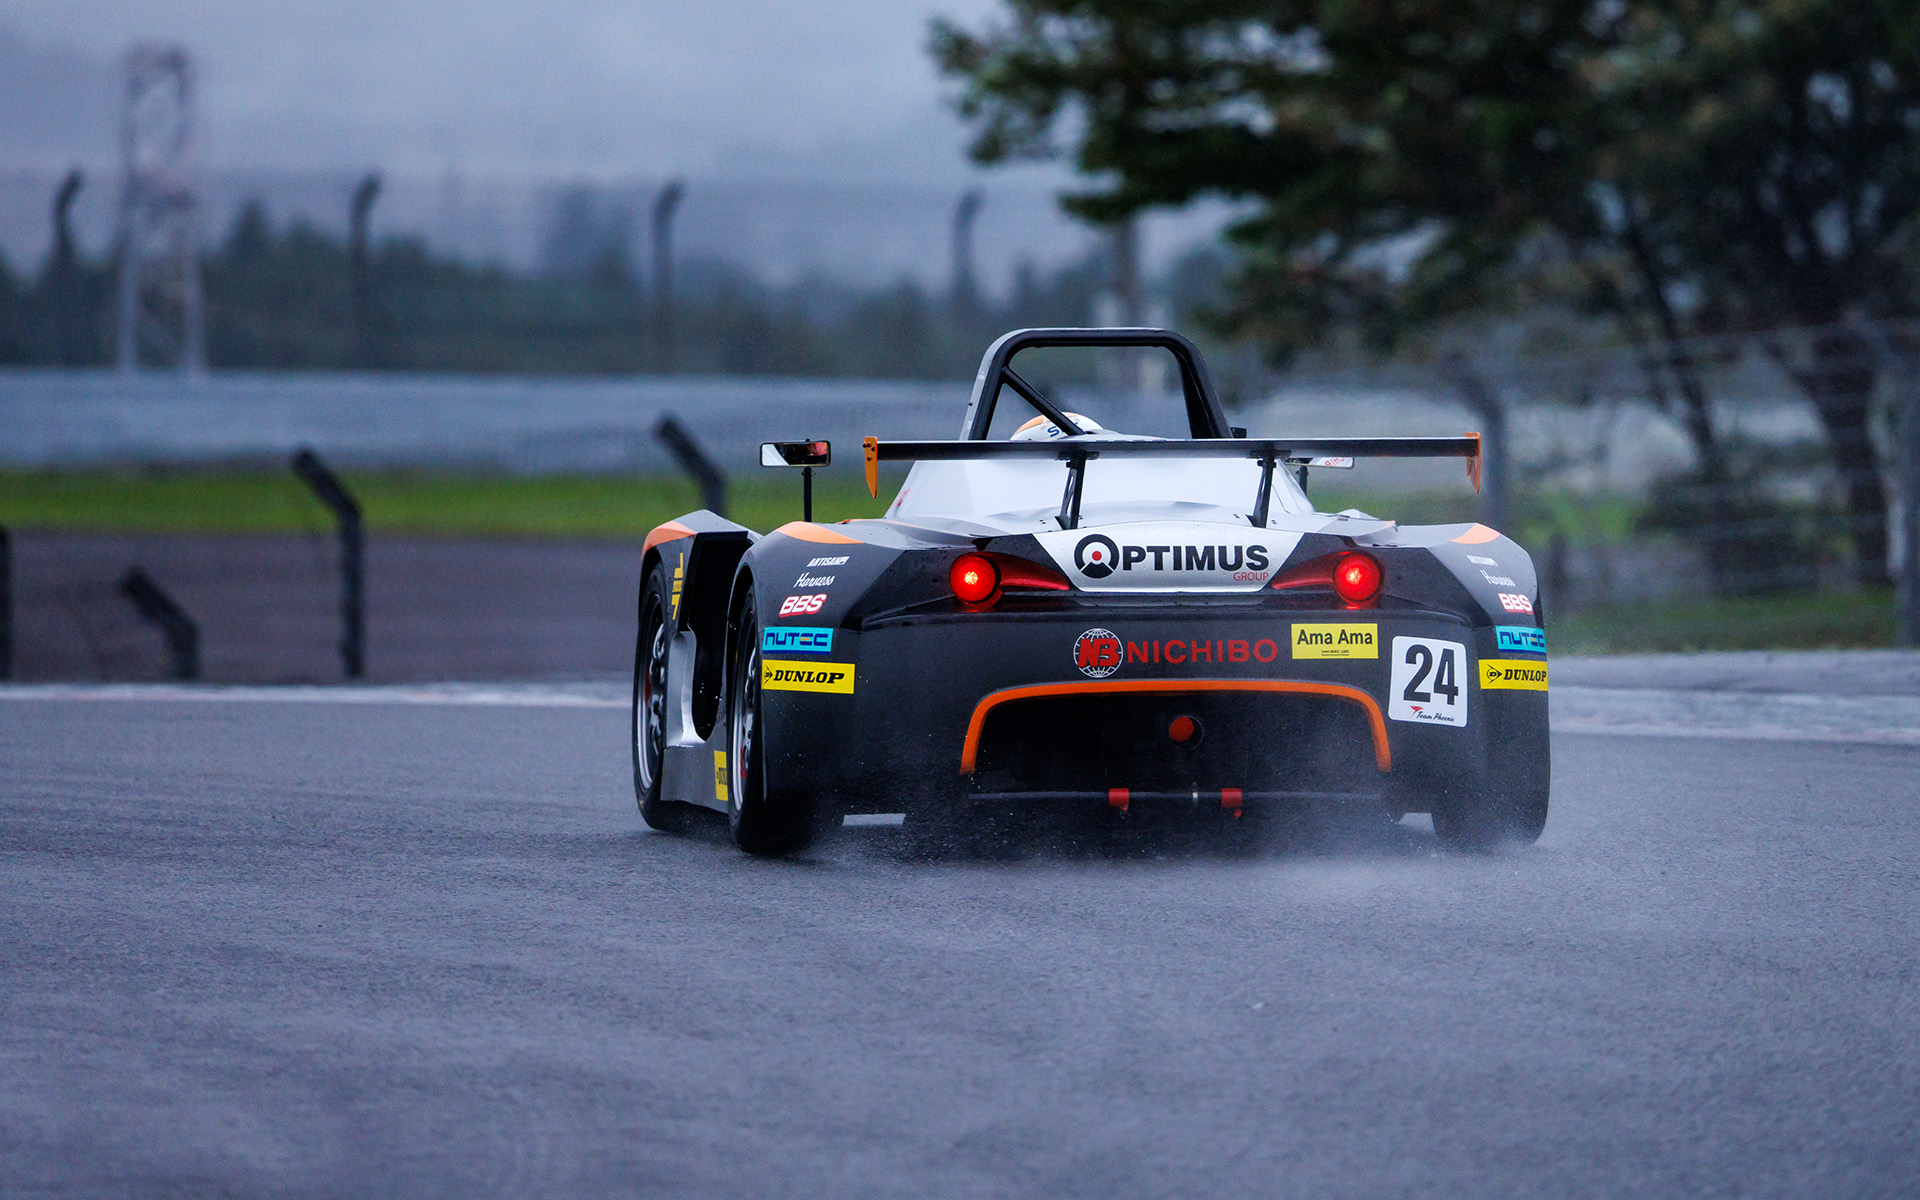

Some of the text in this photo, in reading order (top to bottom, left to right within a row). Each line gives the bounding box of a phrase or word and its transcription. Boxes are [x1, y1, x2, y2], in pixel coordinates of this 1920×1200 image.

[1074, 534, 1269, 579] OPTIMUS
[793, 572, 836, 588] Harness
[1233, 571, 1269, 582] GROUP
[778, 593, 828, 618] BBS
[1497, 592, 1534, 616] BBS
[1297, 629, 1373, 645] Ama Ama
[1127, 638, 1278, 664] NICHIBO
[773, 670, 845, 684] DUNLOP
[1403, 643, 1459, 706] 24
[1503, 669, 1547, 682] DUNLOP
[1416, 711, 1433, 719] Team
